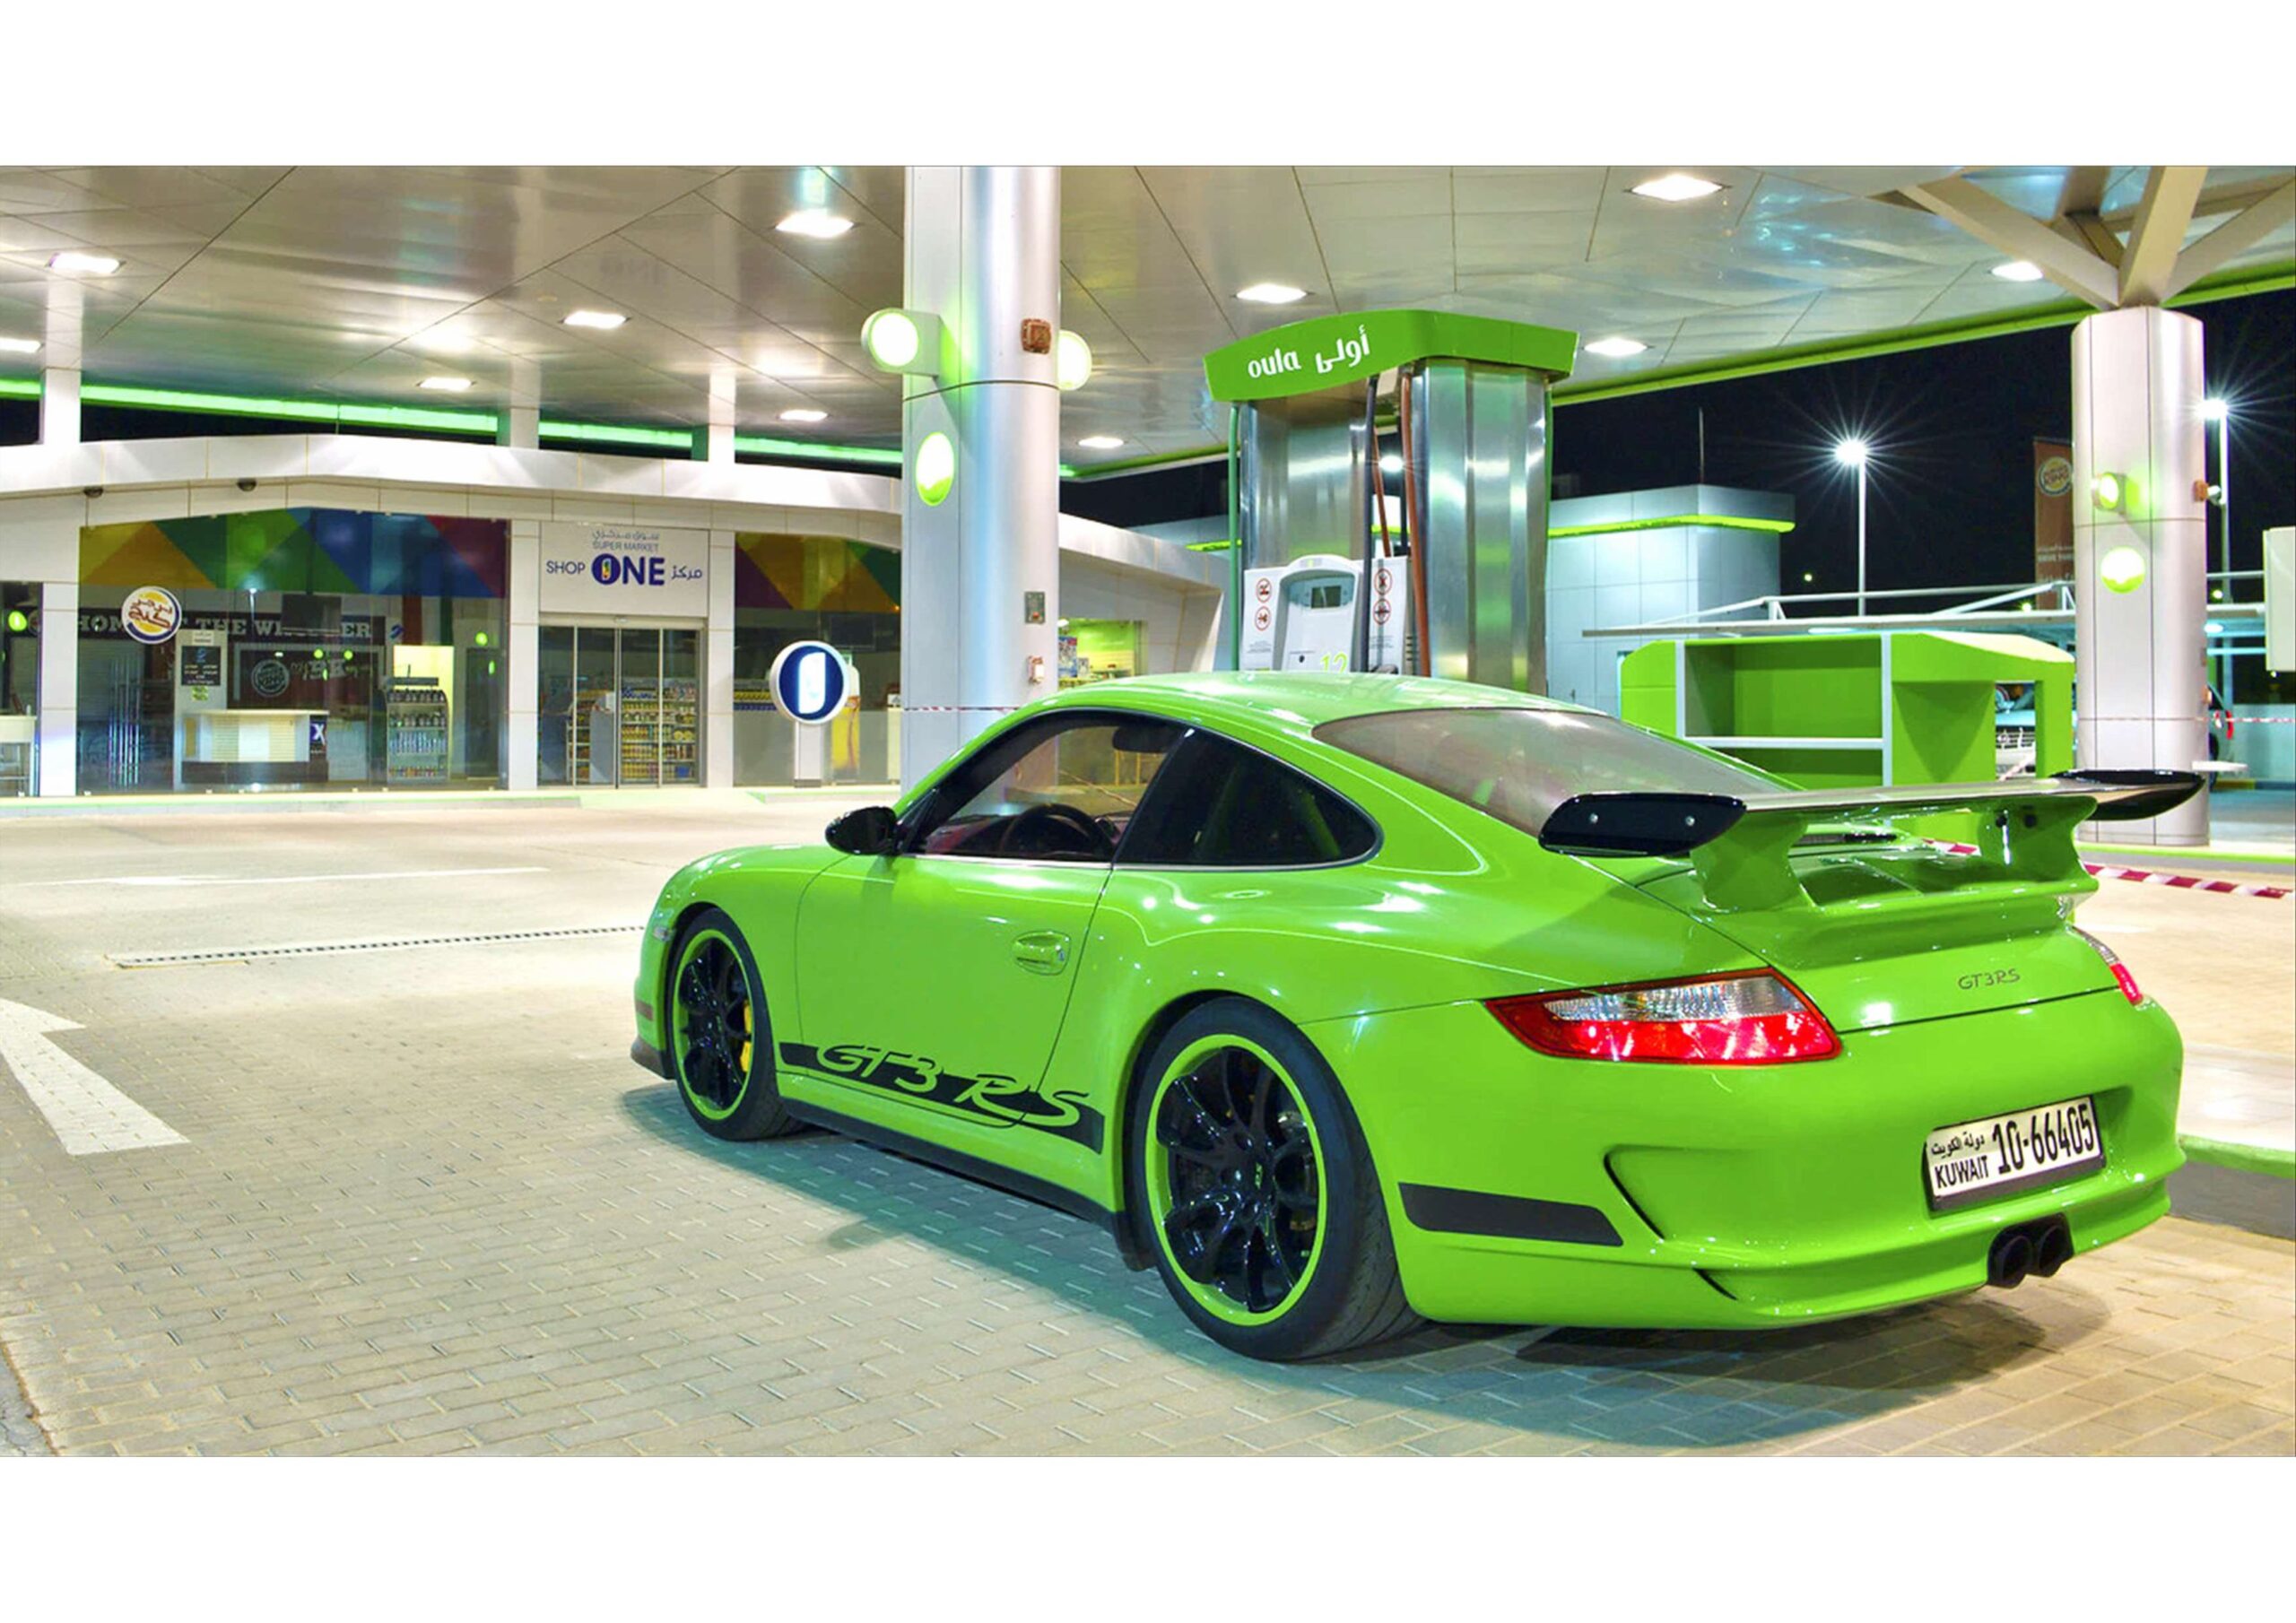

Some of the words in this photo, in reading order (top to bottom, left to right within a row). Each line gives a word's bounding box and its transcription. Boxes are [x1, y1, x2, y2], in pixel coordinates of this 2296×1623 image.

[1248, 347, 1302, 378] oula
[592, 541, 623, 550] SUPER
[624, 542, 660, 552] MARKET
[546, 560, 586, 575] SHOP
[591, 553, 665, 586] ONE
[1963, 1132, 1986, 1151] دولة
[1934, 1155, 1989, 1189] KUWAIT
